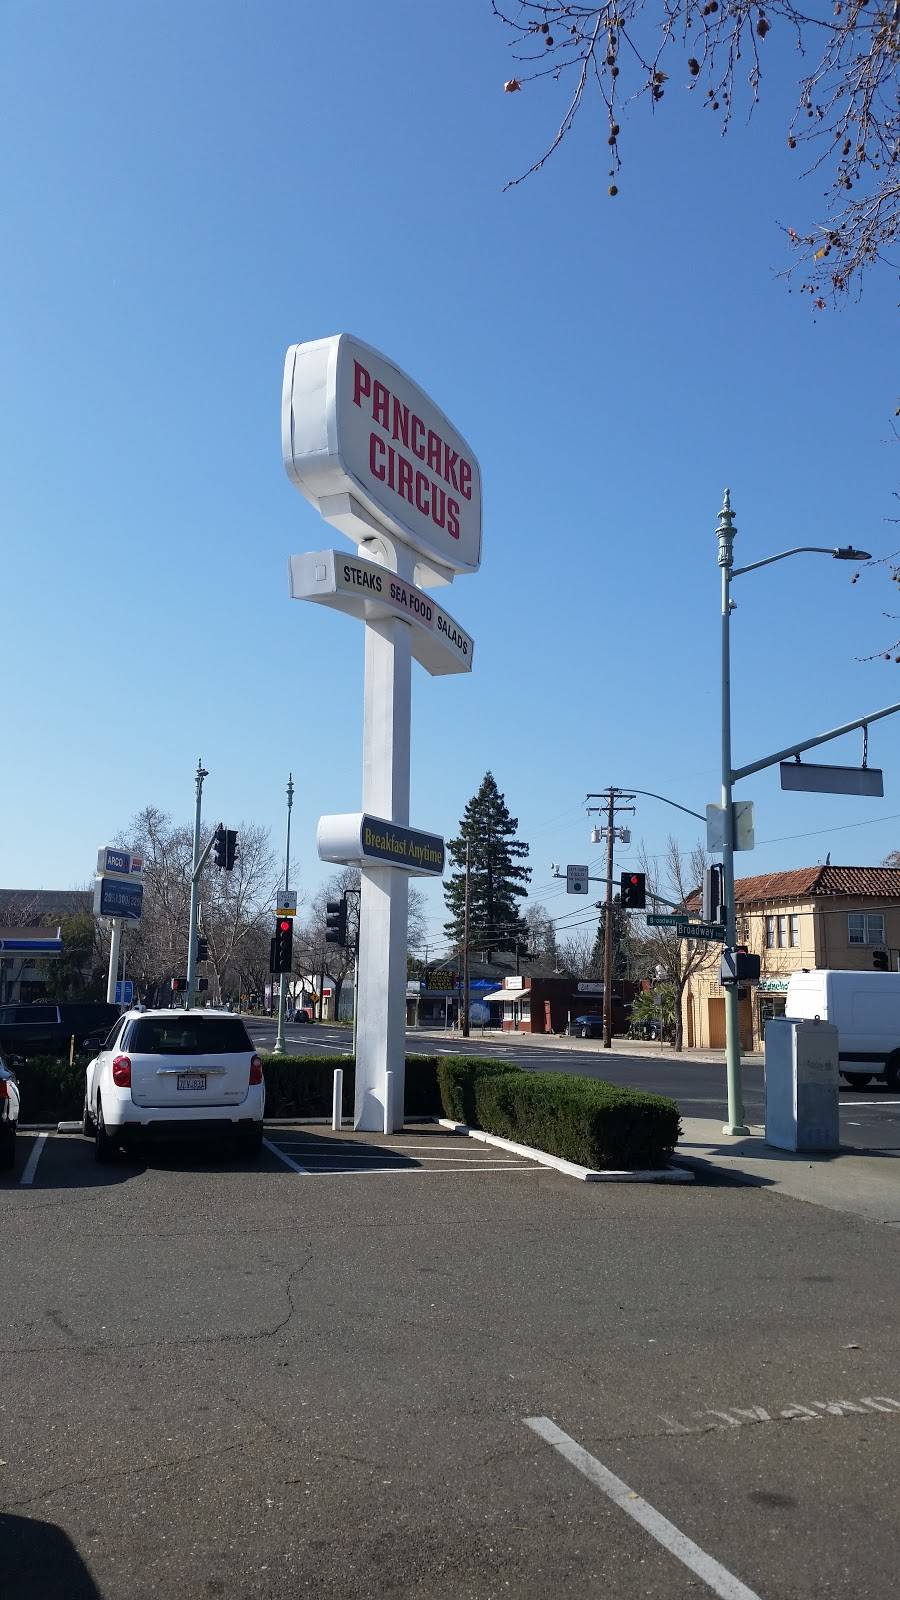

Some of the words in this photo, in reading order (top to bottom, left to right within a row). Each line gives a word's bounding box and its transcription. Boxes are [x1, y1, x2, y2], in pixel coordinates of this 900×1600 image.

[353, 360, 472, 501] PANCAKE
[369, 431, 460, 540] CIRCUS
[343, 565, 383, 593] STEAKS
[437, 615, 468, 655] SALADS
[107, 856, 123, 868] ARCO
[365, 827, 407, 856] Breakfast
[408, 841, 442, 865] Anytime
[649, 918, 676, 926] Broadway
[678, 924, 714, 938] Broadway
